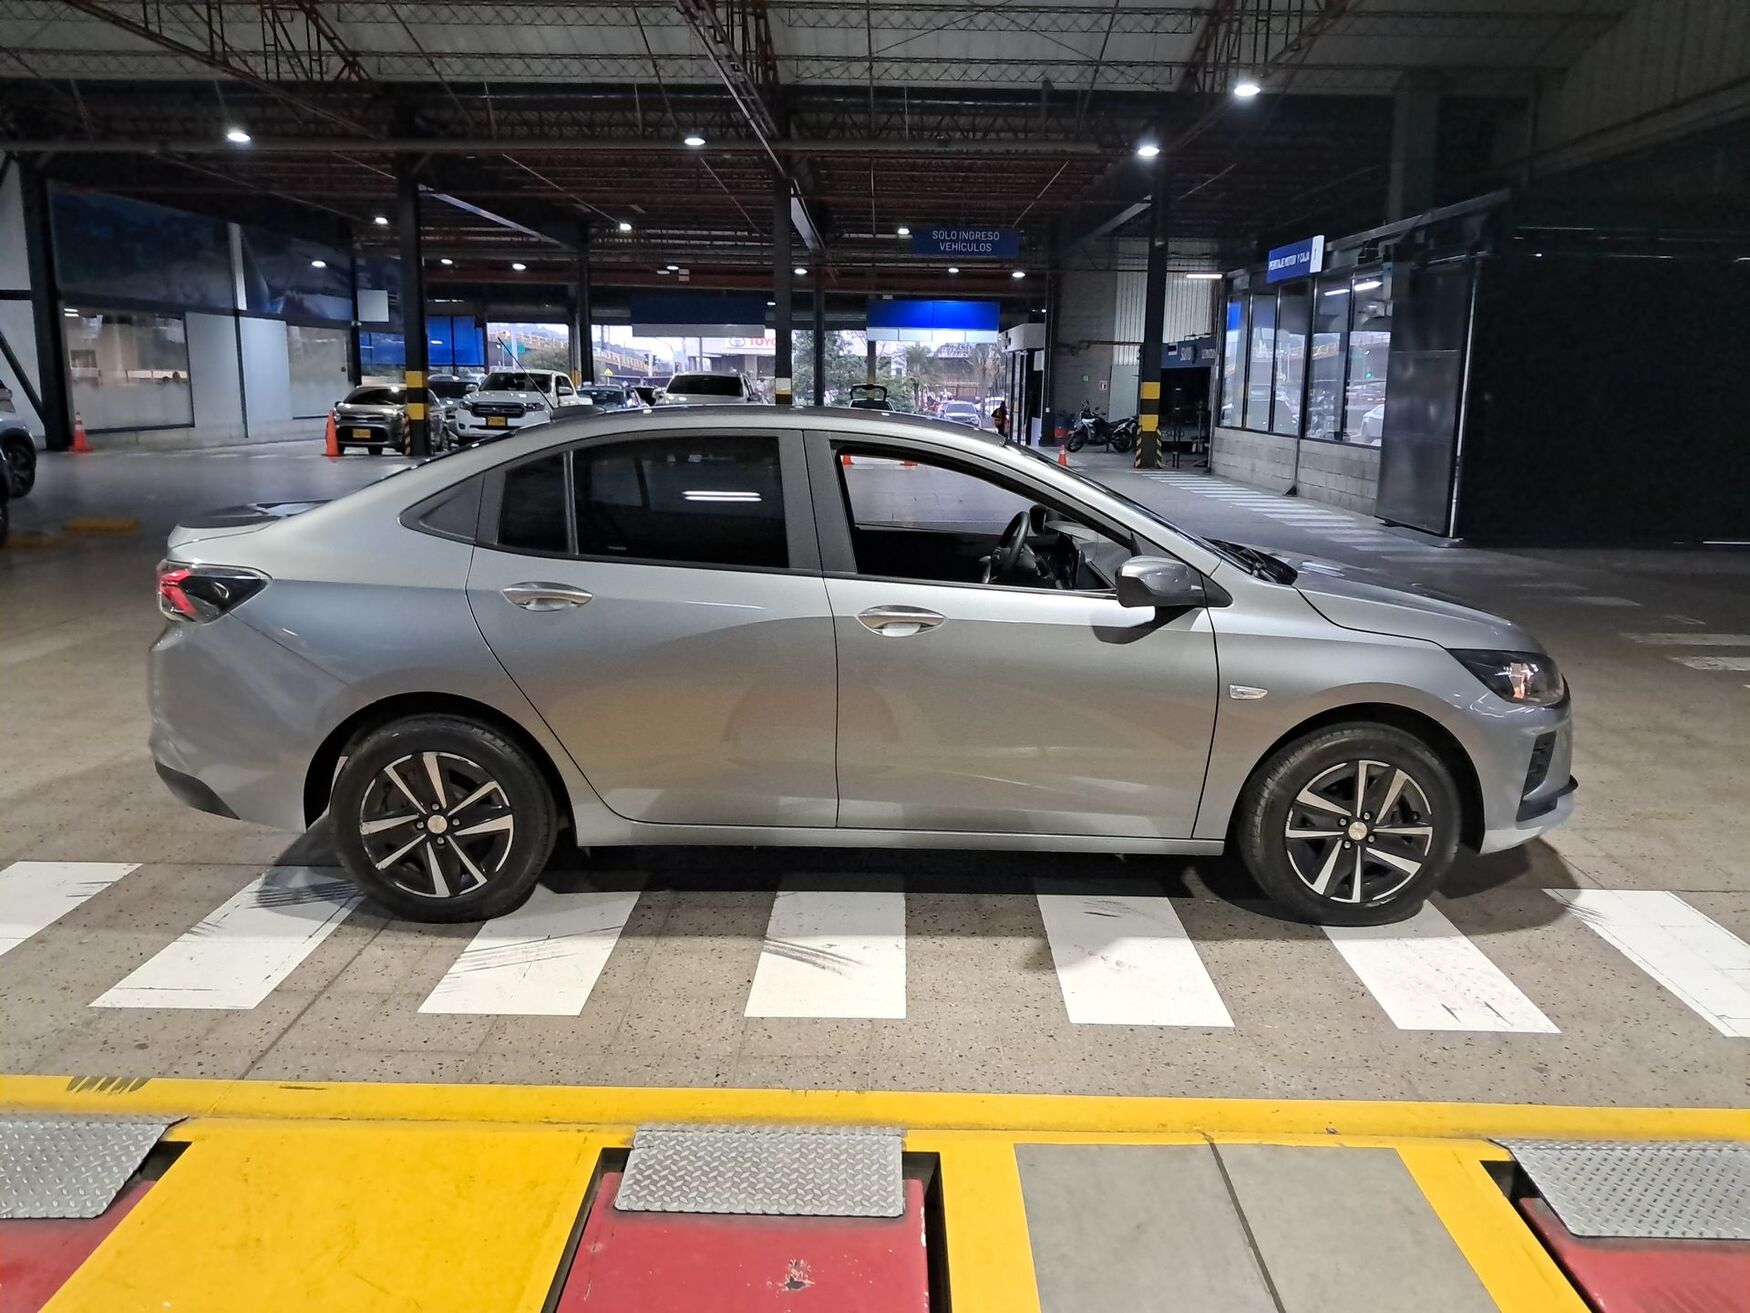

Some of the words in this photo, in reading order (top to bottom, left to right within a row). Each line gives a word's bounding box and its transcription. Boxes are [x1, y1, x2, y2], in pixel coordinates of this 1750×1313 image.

[932, 230, 957, 240] SOLO
[960, 231, 1000, 241] INGRESO
[939, 241, 992, 252] VEHÍCULOS
